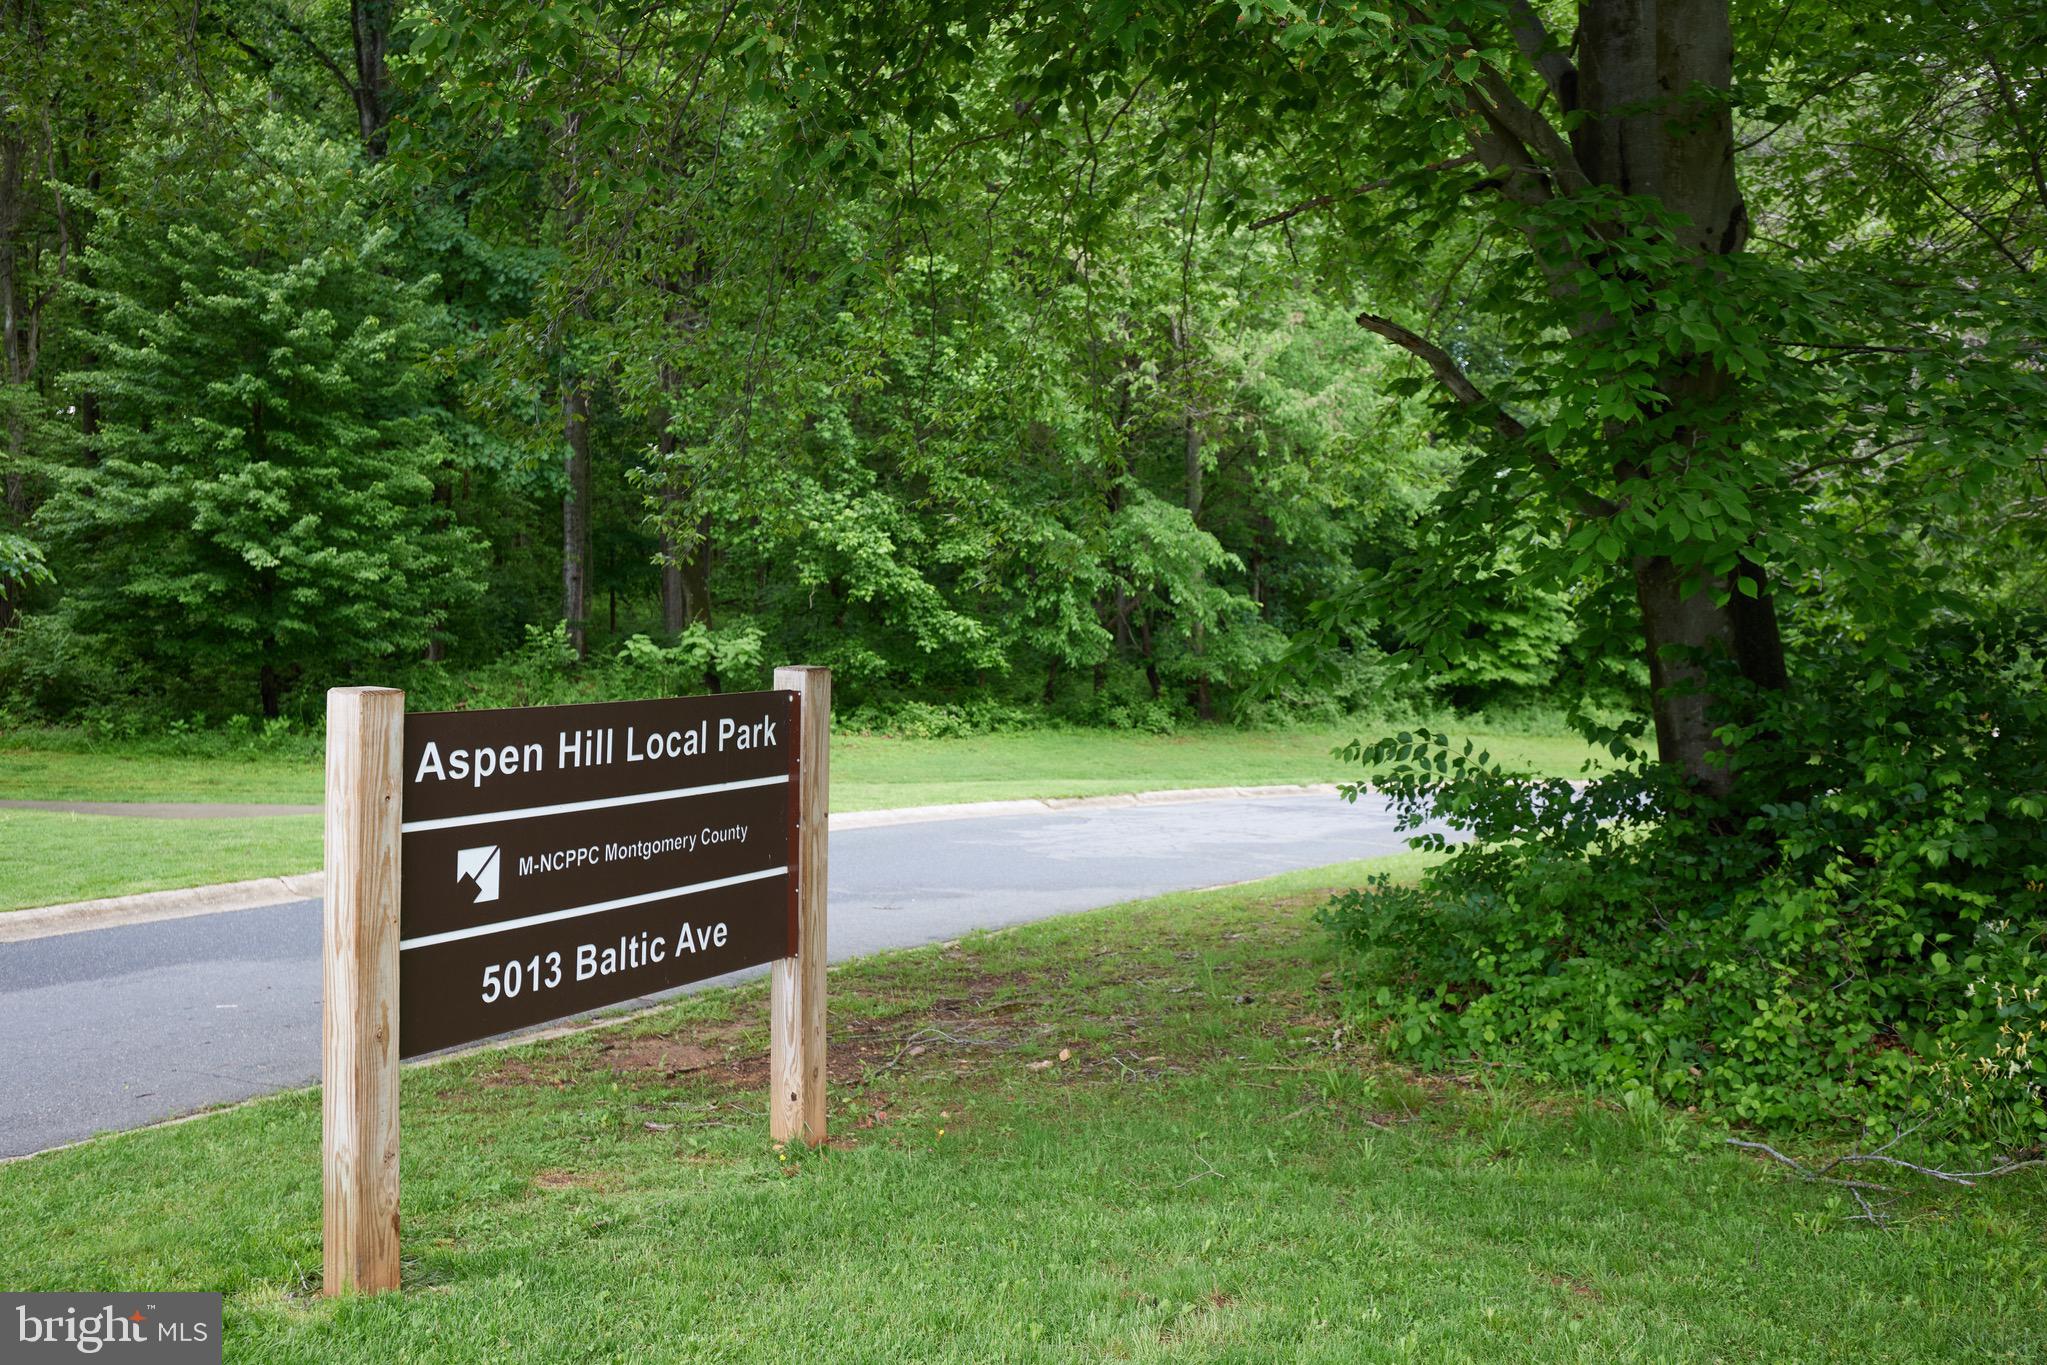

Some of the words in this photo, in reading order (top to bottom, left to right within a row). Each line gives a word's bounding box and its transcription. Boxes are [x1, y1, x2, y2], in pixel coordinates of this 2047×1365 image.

[414, 741, 543, 787] Aspen
[558, 728, 613, 768] Hill
[626, 720, 707, 762] Local
[718, 714, 777, 750] Park
[518, 845, 599, 876] M-NCPPC
[604, 833, 697, 861] Montgomery
[701, 824, 748, 846] County
[481, 951, 561, 1004] 5013
[576, 930, 666, 981] Baltic
[675, 921, 728, 958] Ave
